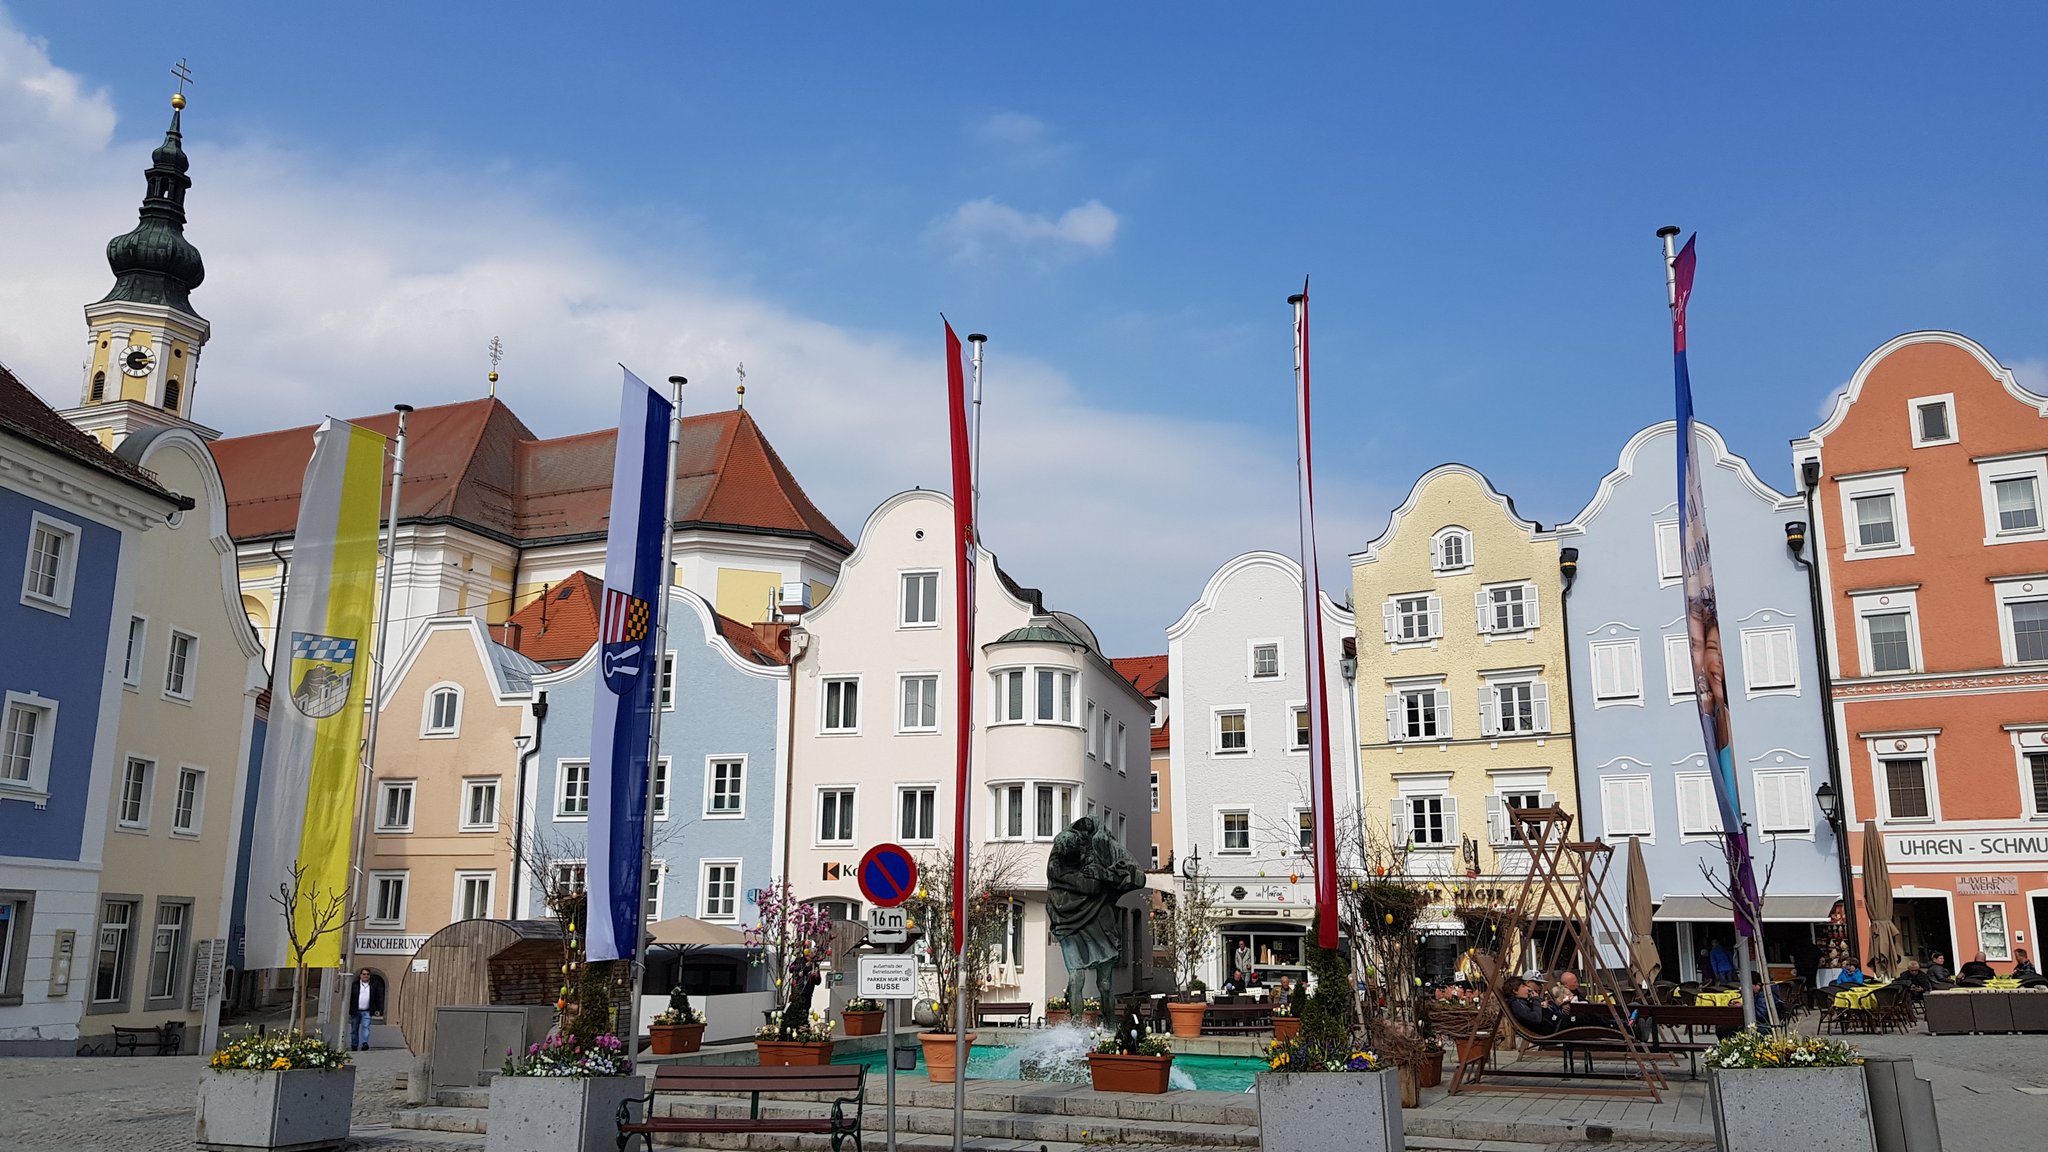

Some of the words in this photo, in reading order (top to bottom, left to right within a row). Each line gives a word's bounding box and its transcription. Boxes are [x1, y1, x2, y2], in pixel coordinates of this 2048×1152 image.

[1900, 839, 1963, 856] UHREN
[1980, 837, 2048, 854] SCHMU
[1970, 883, 2001, 891] WERK
[871, 910, 885, 927] 16
[888, 914, 903, 928] m
[355, 937, 428, 950] VERSICHERUNG
